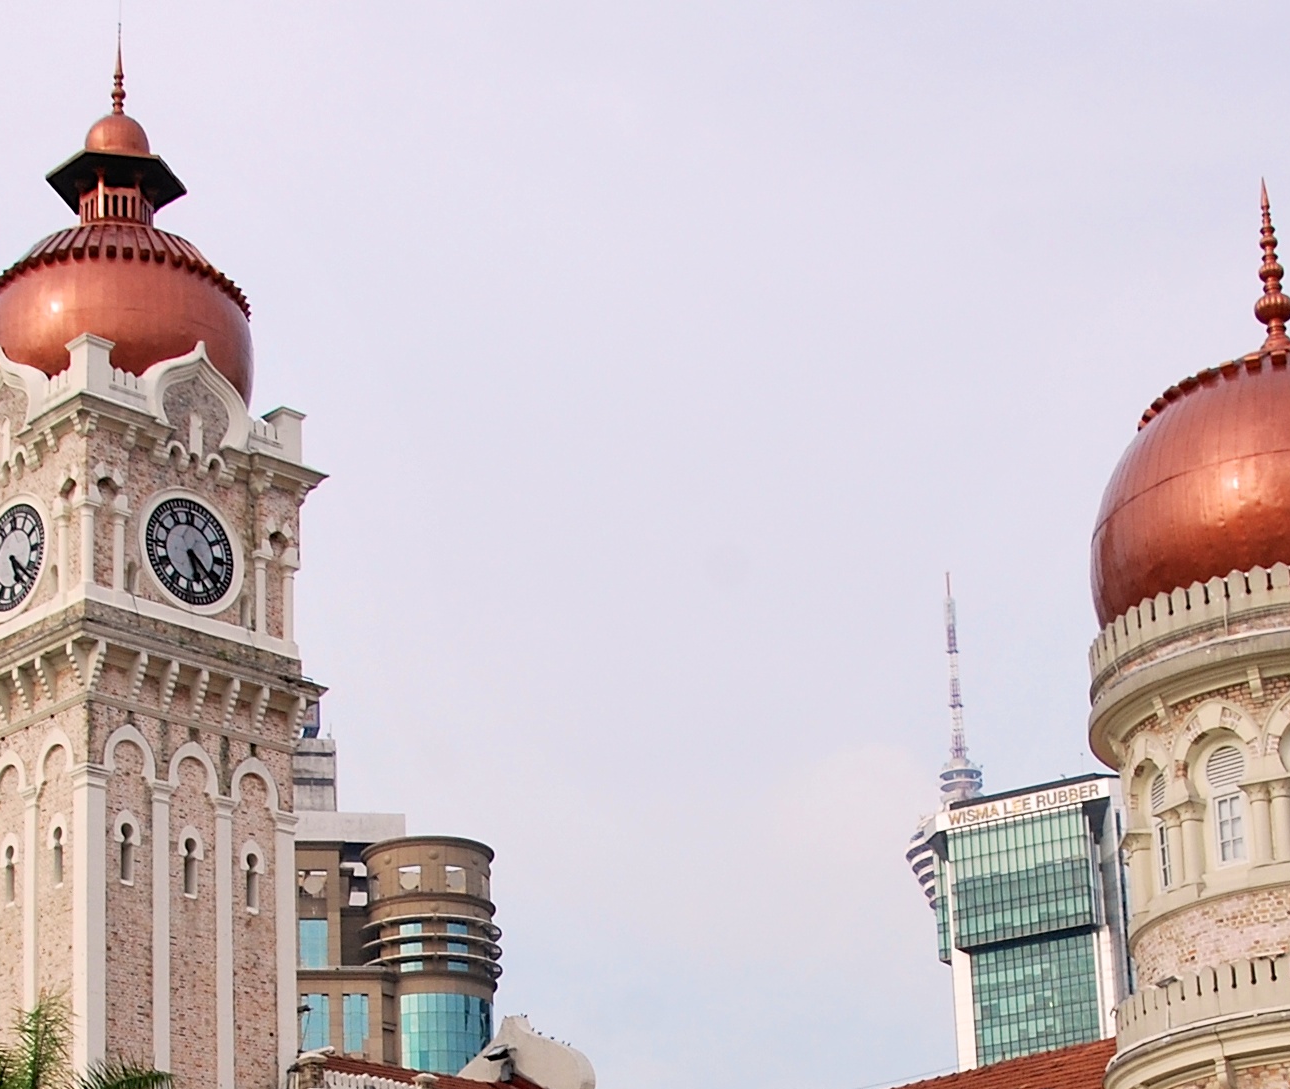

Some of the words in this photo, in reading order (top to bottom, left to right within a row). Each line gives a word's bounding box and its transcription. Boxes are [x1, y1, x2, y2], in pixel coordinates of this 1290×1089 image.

[948, 804, 999, 826] WISMA
[1003, 797, 1031, 819] LEE
[1036, 784, 1099, 808] RUBBER
